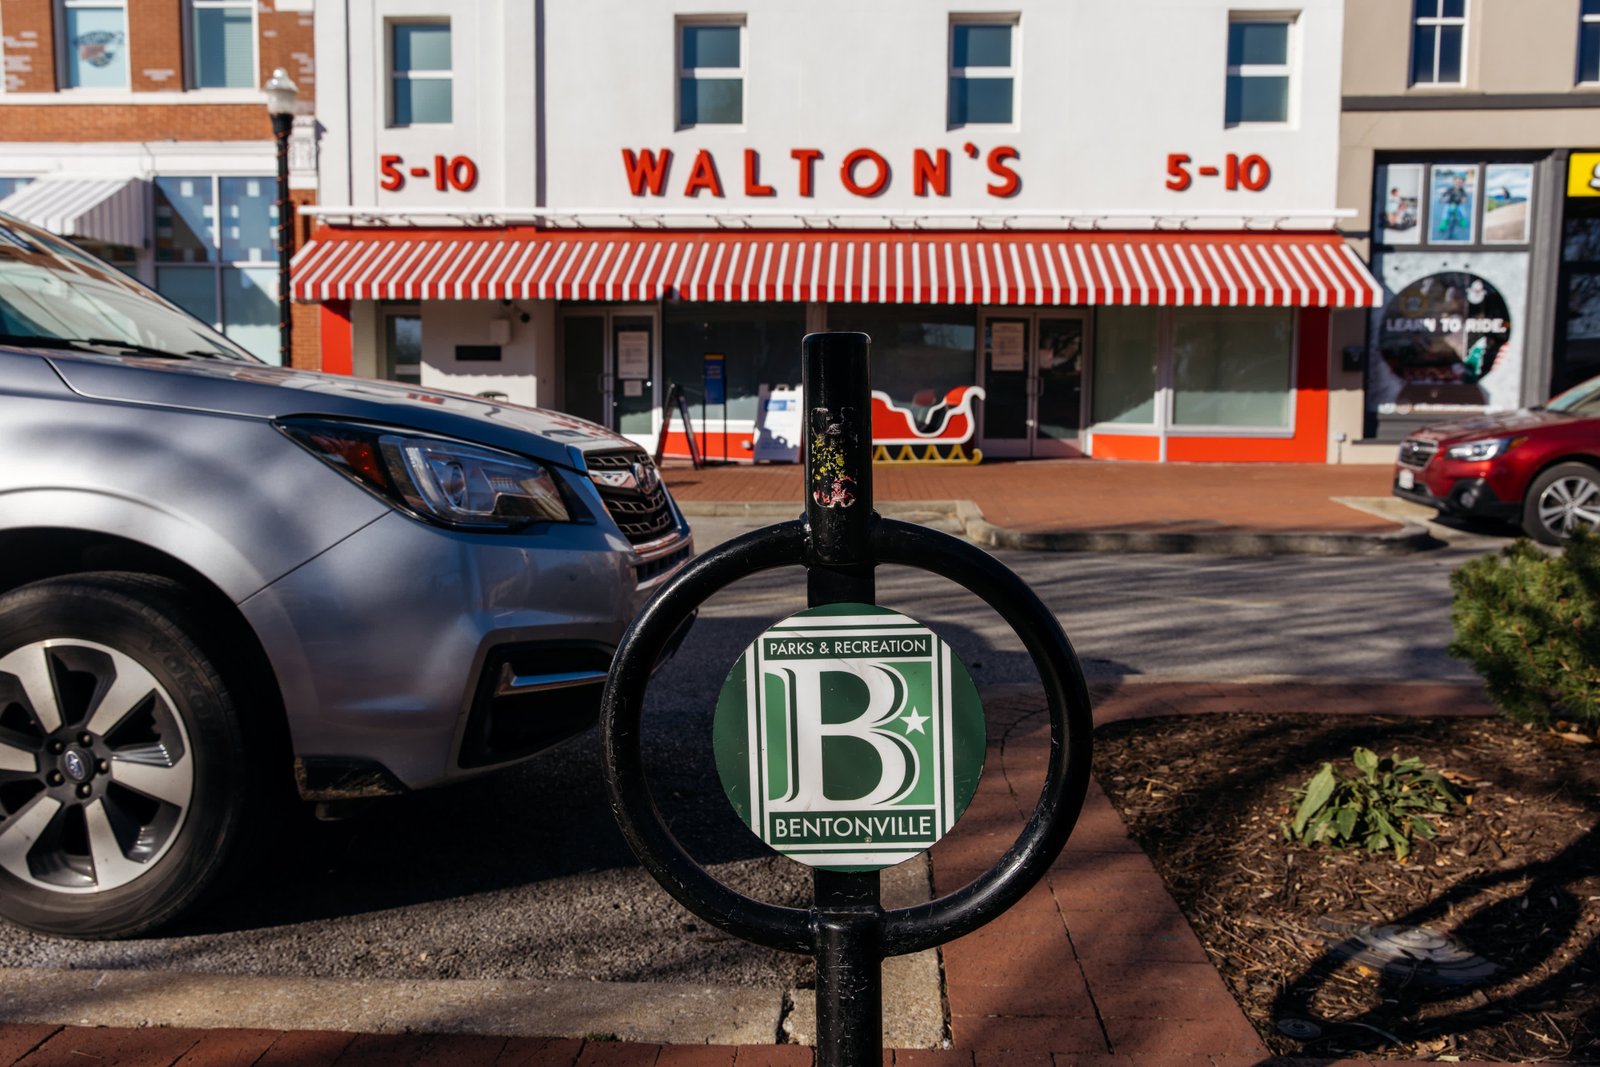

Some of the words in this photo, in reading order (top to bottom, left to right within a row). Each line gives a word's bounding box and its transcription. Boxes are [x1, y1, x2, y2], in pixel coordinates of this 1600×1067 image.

[380, 154, 479, 192] 5-10
[621, 142, 1021, 198] WALTON'S
[1166, 153, 1271, 192] 5-10
[1386, 318, 1436, 332] LEARN
[1440, 318, 1461, 332] TO
[770, 641, 815, 655] PARKS
[819, 641, 830, 654] &
[834, 639, 926, 653] RECREATION
[780, 662, 921, 807] B
[775, 816, 932, 838] BENTONVILLE
